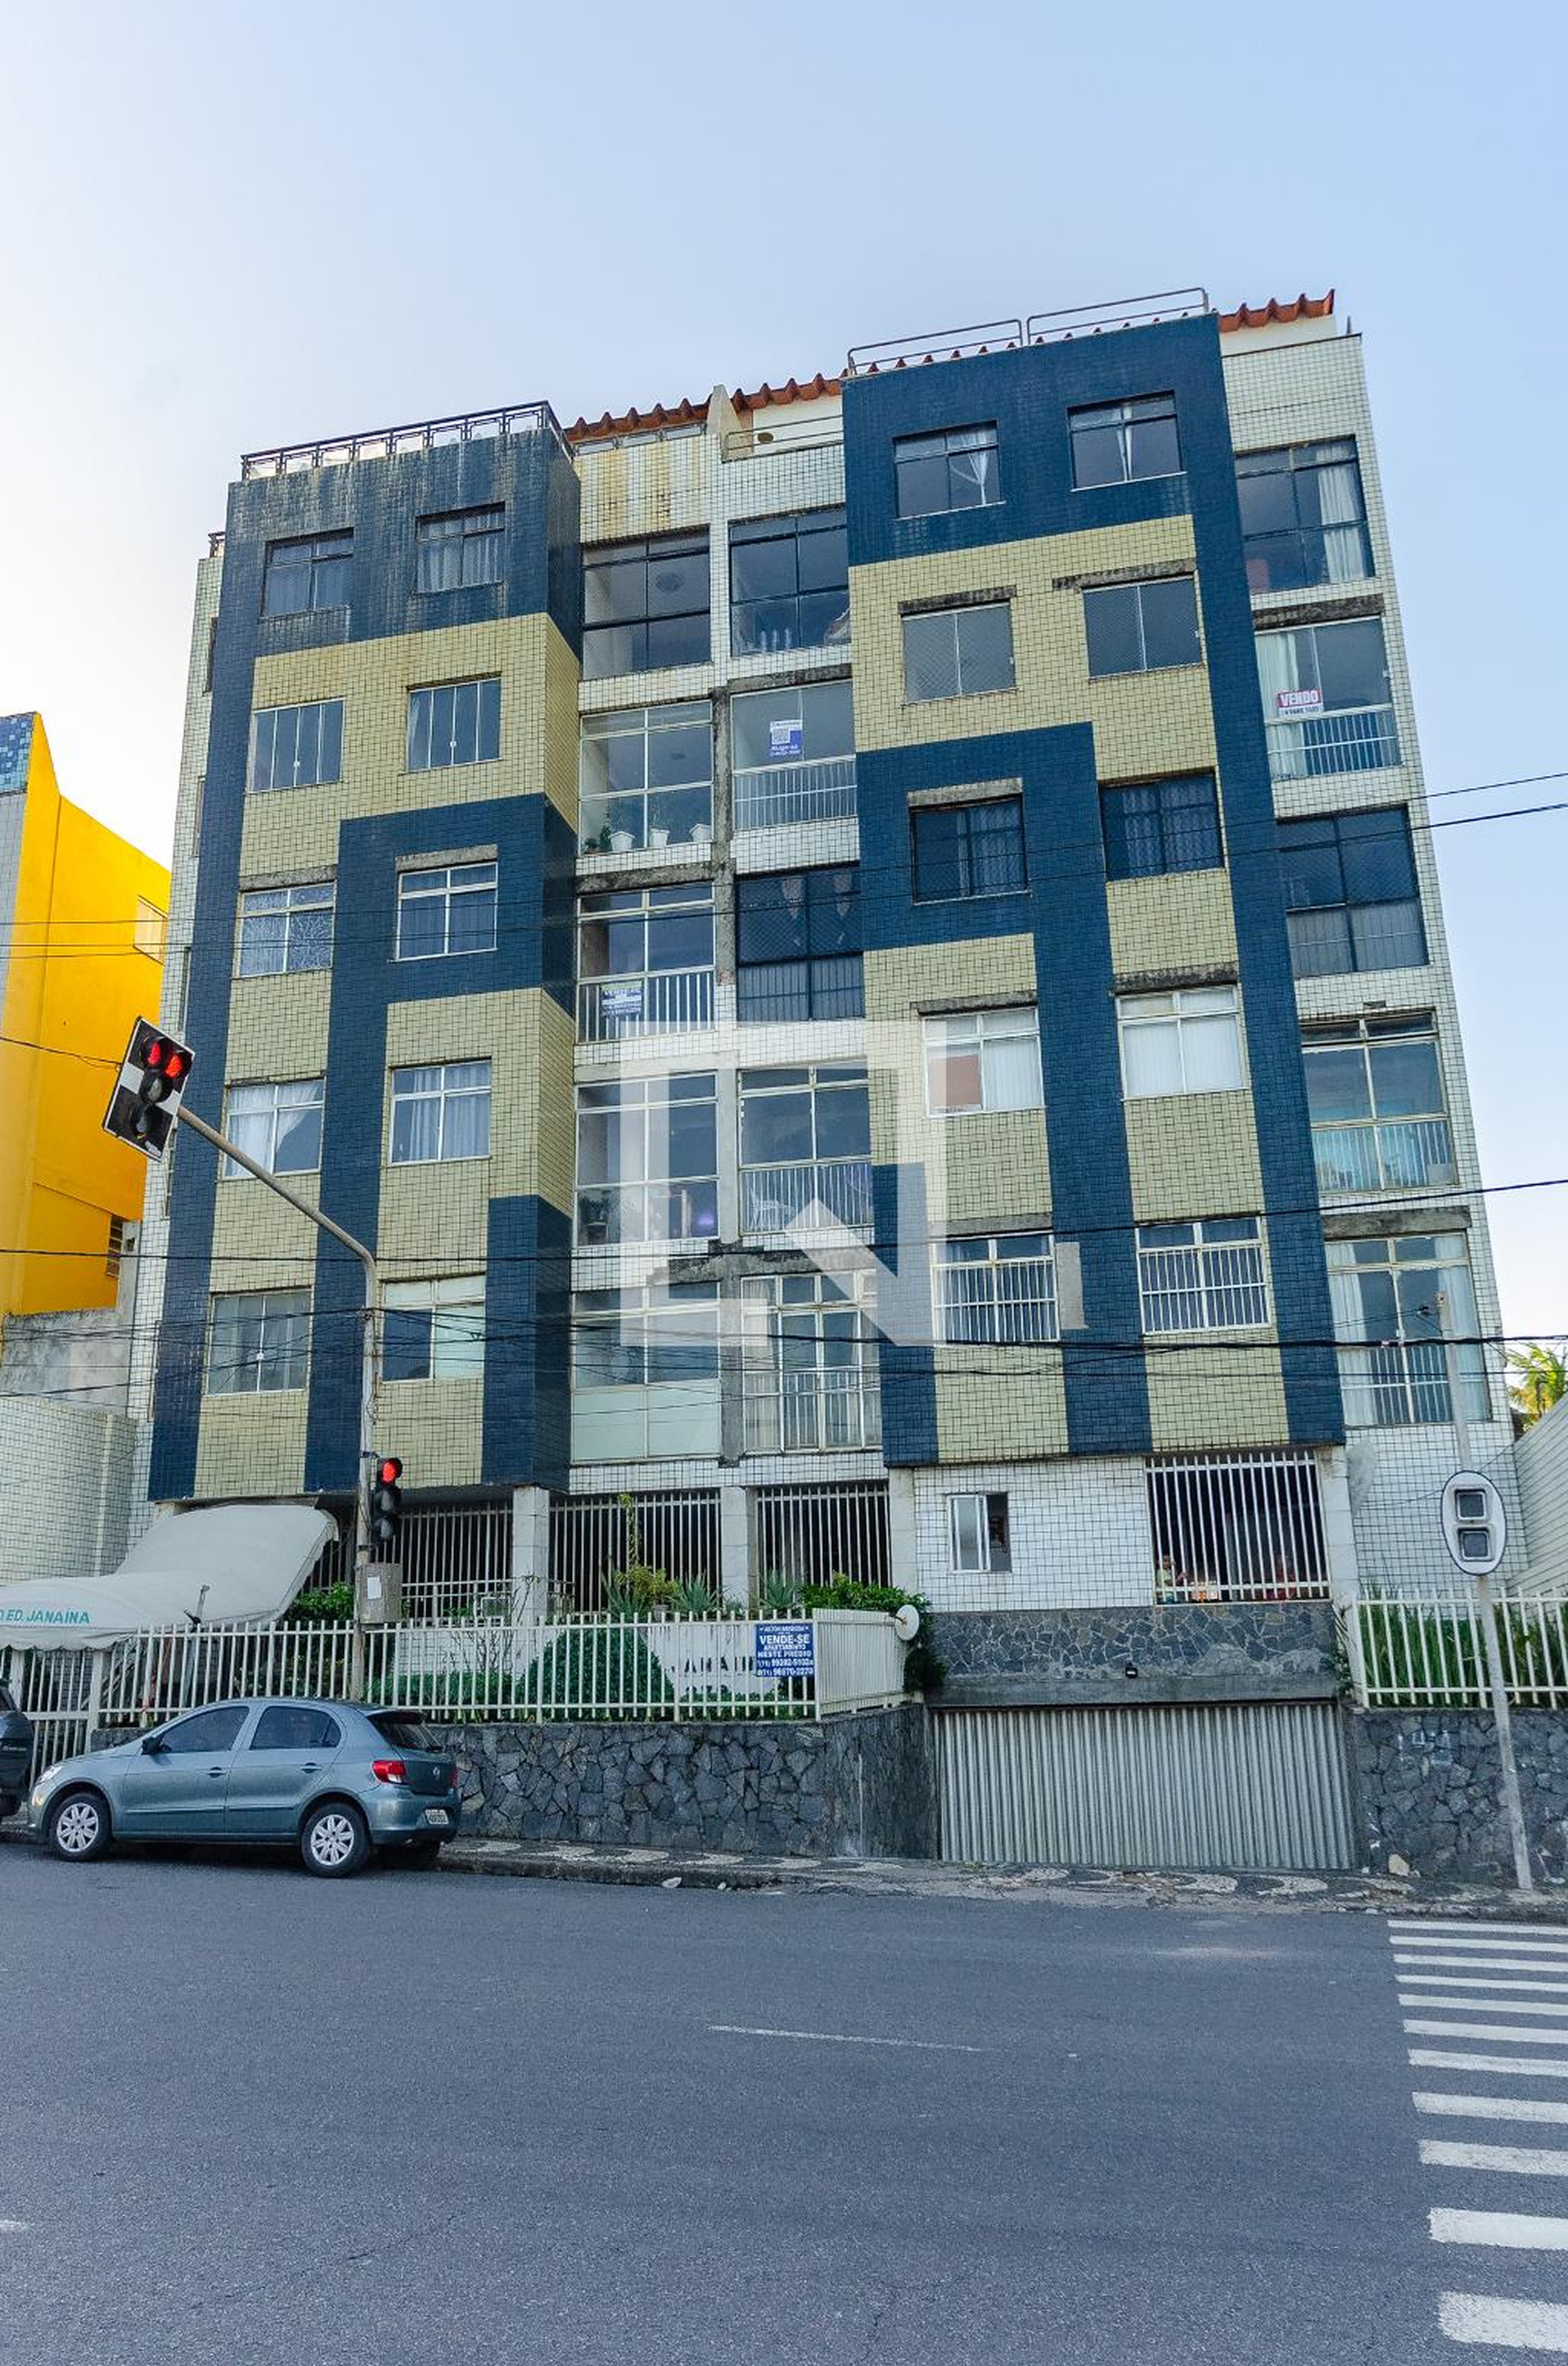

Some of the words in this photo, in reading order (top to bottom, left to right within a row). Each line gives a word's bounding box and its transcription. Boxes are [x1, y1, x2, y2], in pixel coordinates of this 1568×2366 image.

[1280, 690, 1319, 706] VENDO
[27, 1608, 89, 1624] JANAÍNA
[760, 1633, 810, 1645] VENDE-SE
